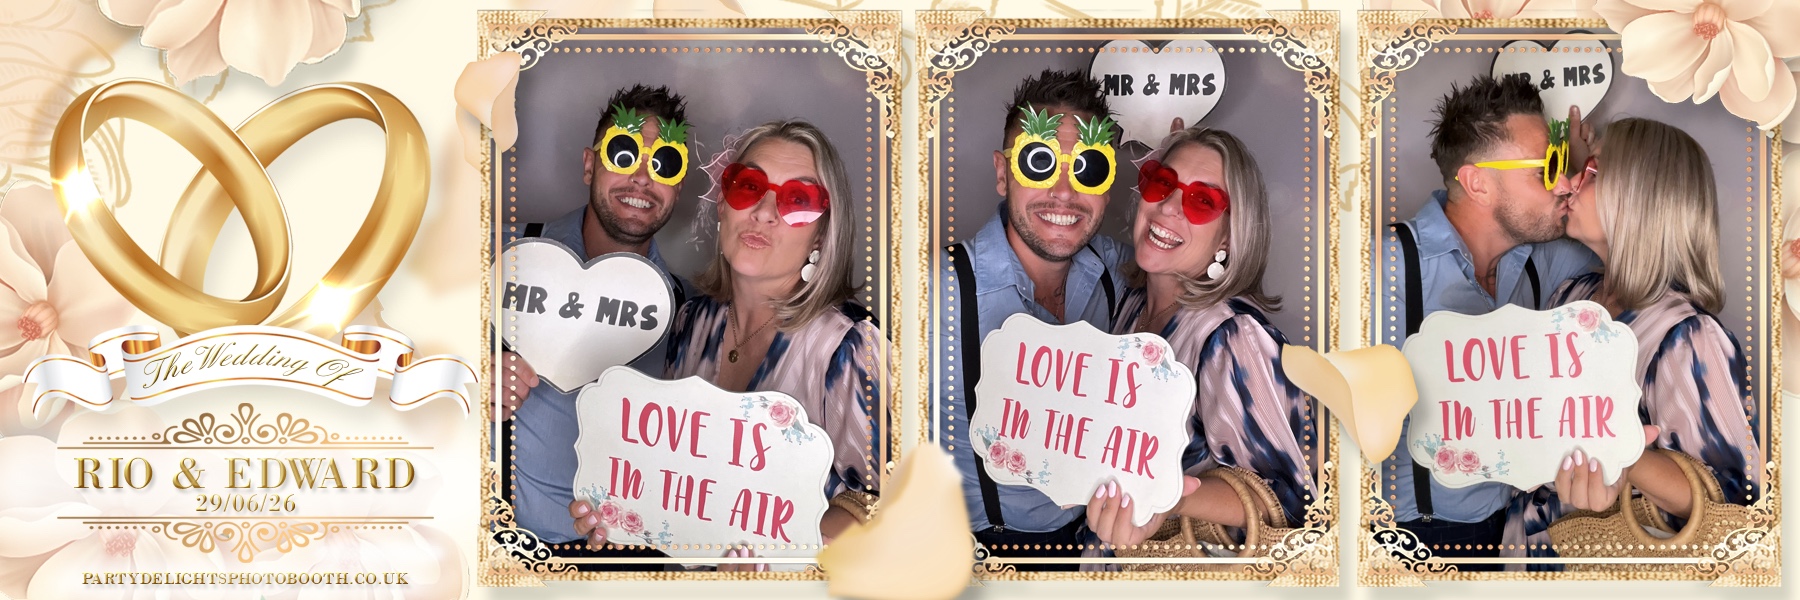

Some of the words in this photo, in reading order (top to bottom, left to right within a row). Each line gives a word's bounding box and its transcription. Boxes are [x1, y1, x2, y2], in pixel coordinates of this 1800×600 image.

[1104, 74, 1134, 96] MR
[1142, 73, 1160, 96] &
[1169, 73, 1216, 96] MRS
[1540, 69, 1555, 90] &
[1563, 63, 1606, 87] MRS
[502, 281, 548, 315] MR
[558, 291, 585, 320] &
[594, 295, 659, 331] MRS
[1015, 341, 1093, 397] LOVE
[1103, 357, 1142, 409] IS
[1444, 335, 1530, 382] LOVE
[1544, 331, 1586, 378] IS
[621, 397, 712, 459] LOVE
[727, 418, 771, 472] IS
[1488, 397, 1544, 440] THE
[1558, 395, 1616, 439] AIR
[1044, 408, 1094, 459] THE
[1101, 425, 1159, 480] AIR
[660, 469, 718, 522] THE
[728, 489, 795, 543] AIR
